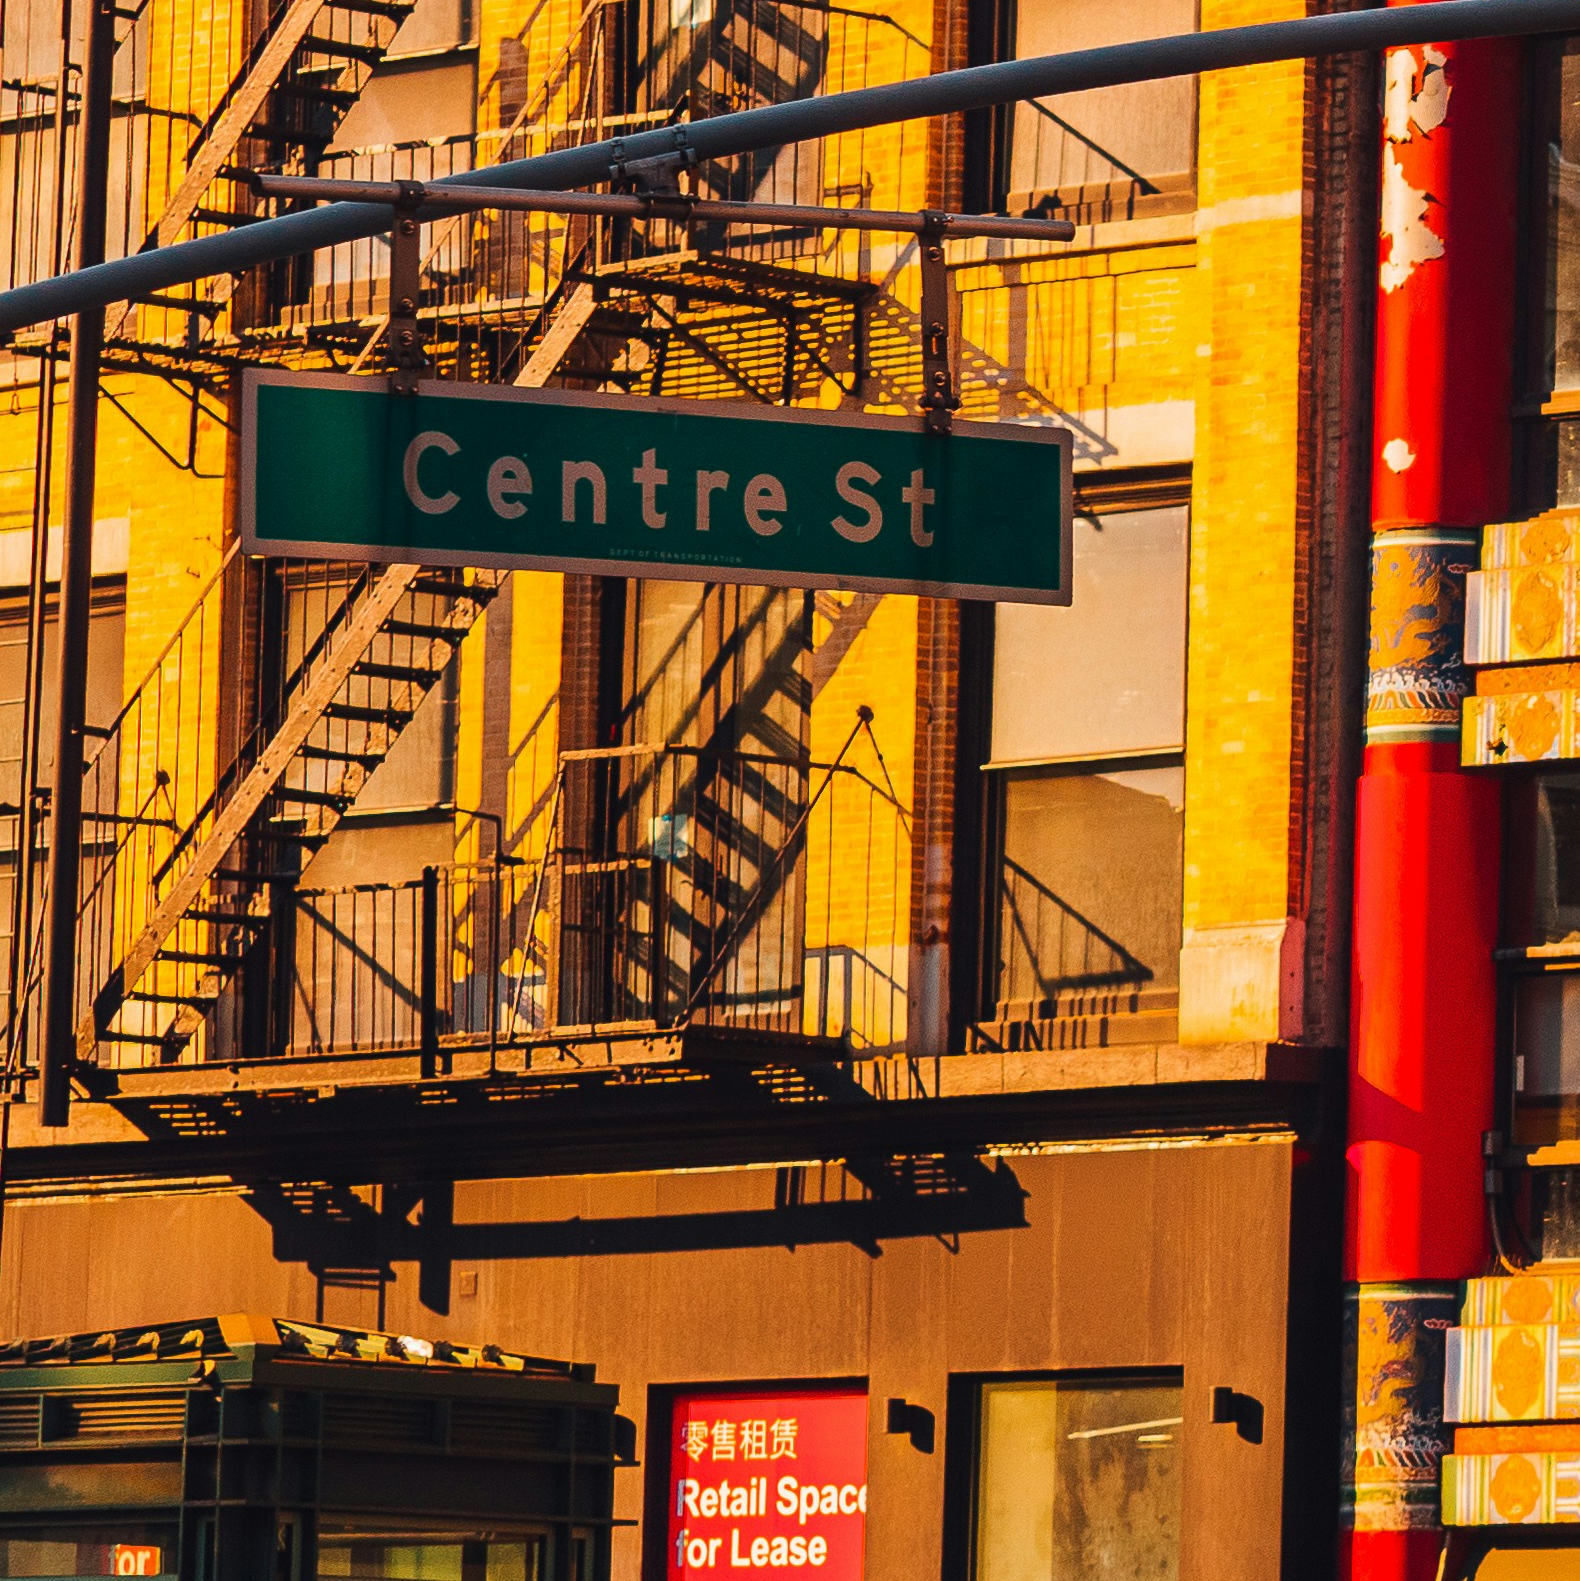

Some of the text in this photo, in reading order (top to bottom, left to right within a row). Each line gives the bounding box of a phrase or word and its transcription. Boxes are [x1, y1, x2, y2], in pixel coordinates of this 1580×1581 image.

[403, 430, 936, 548] Centre St
[681, 1418, 797, 1461] 零售租赁
[677, 1477, 767, 1517] Retail
[676, 1528, 827, 1568] for Lease
